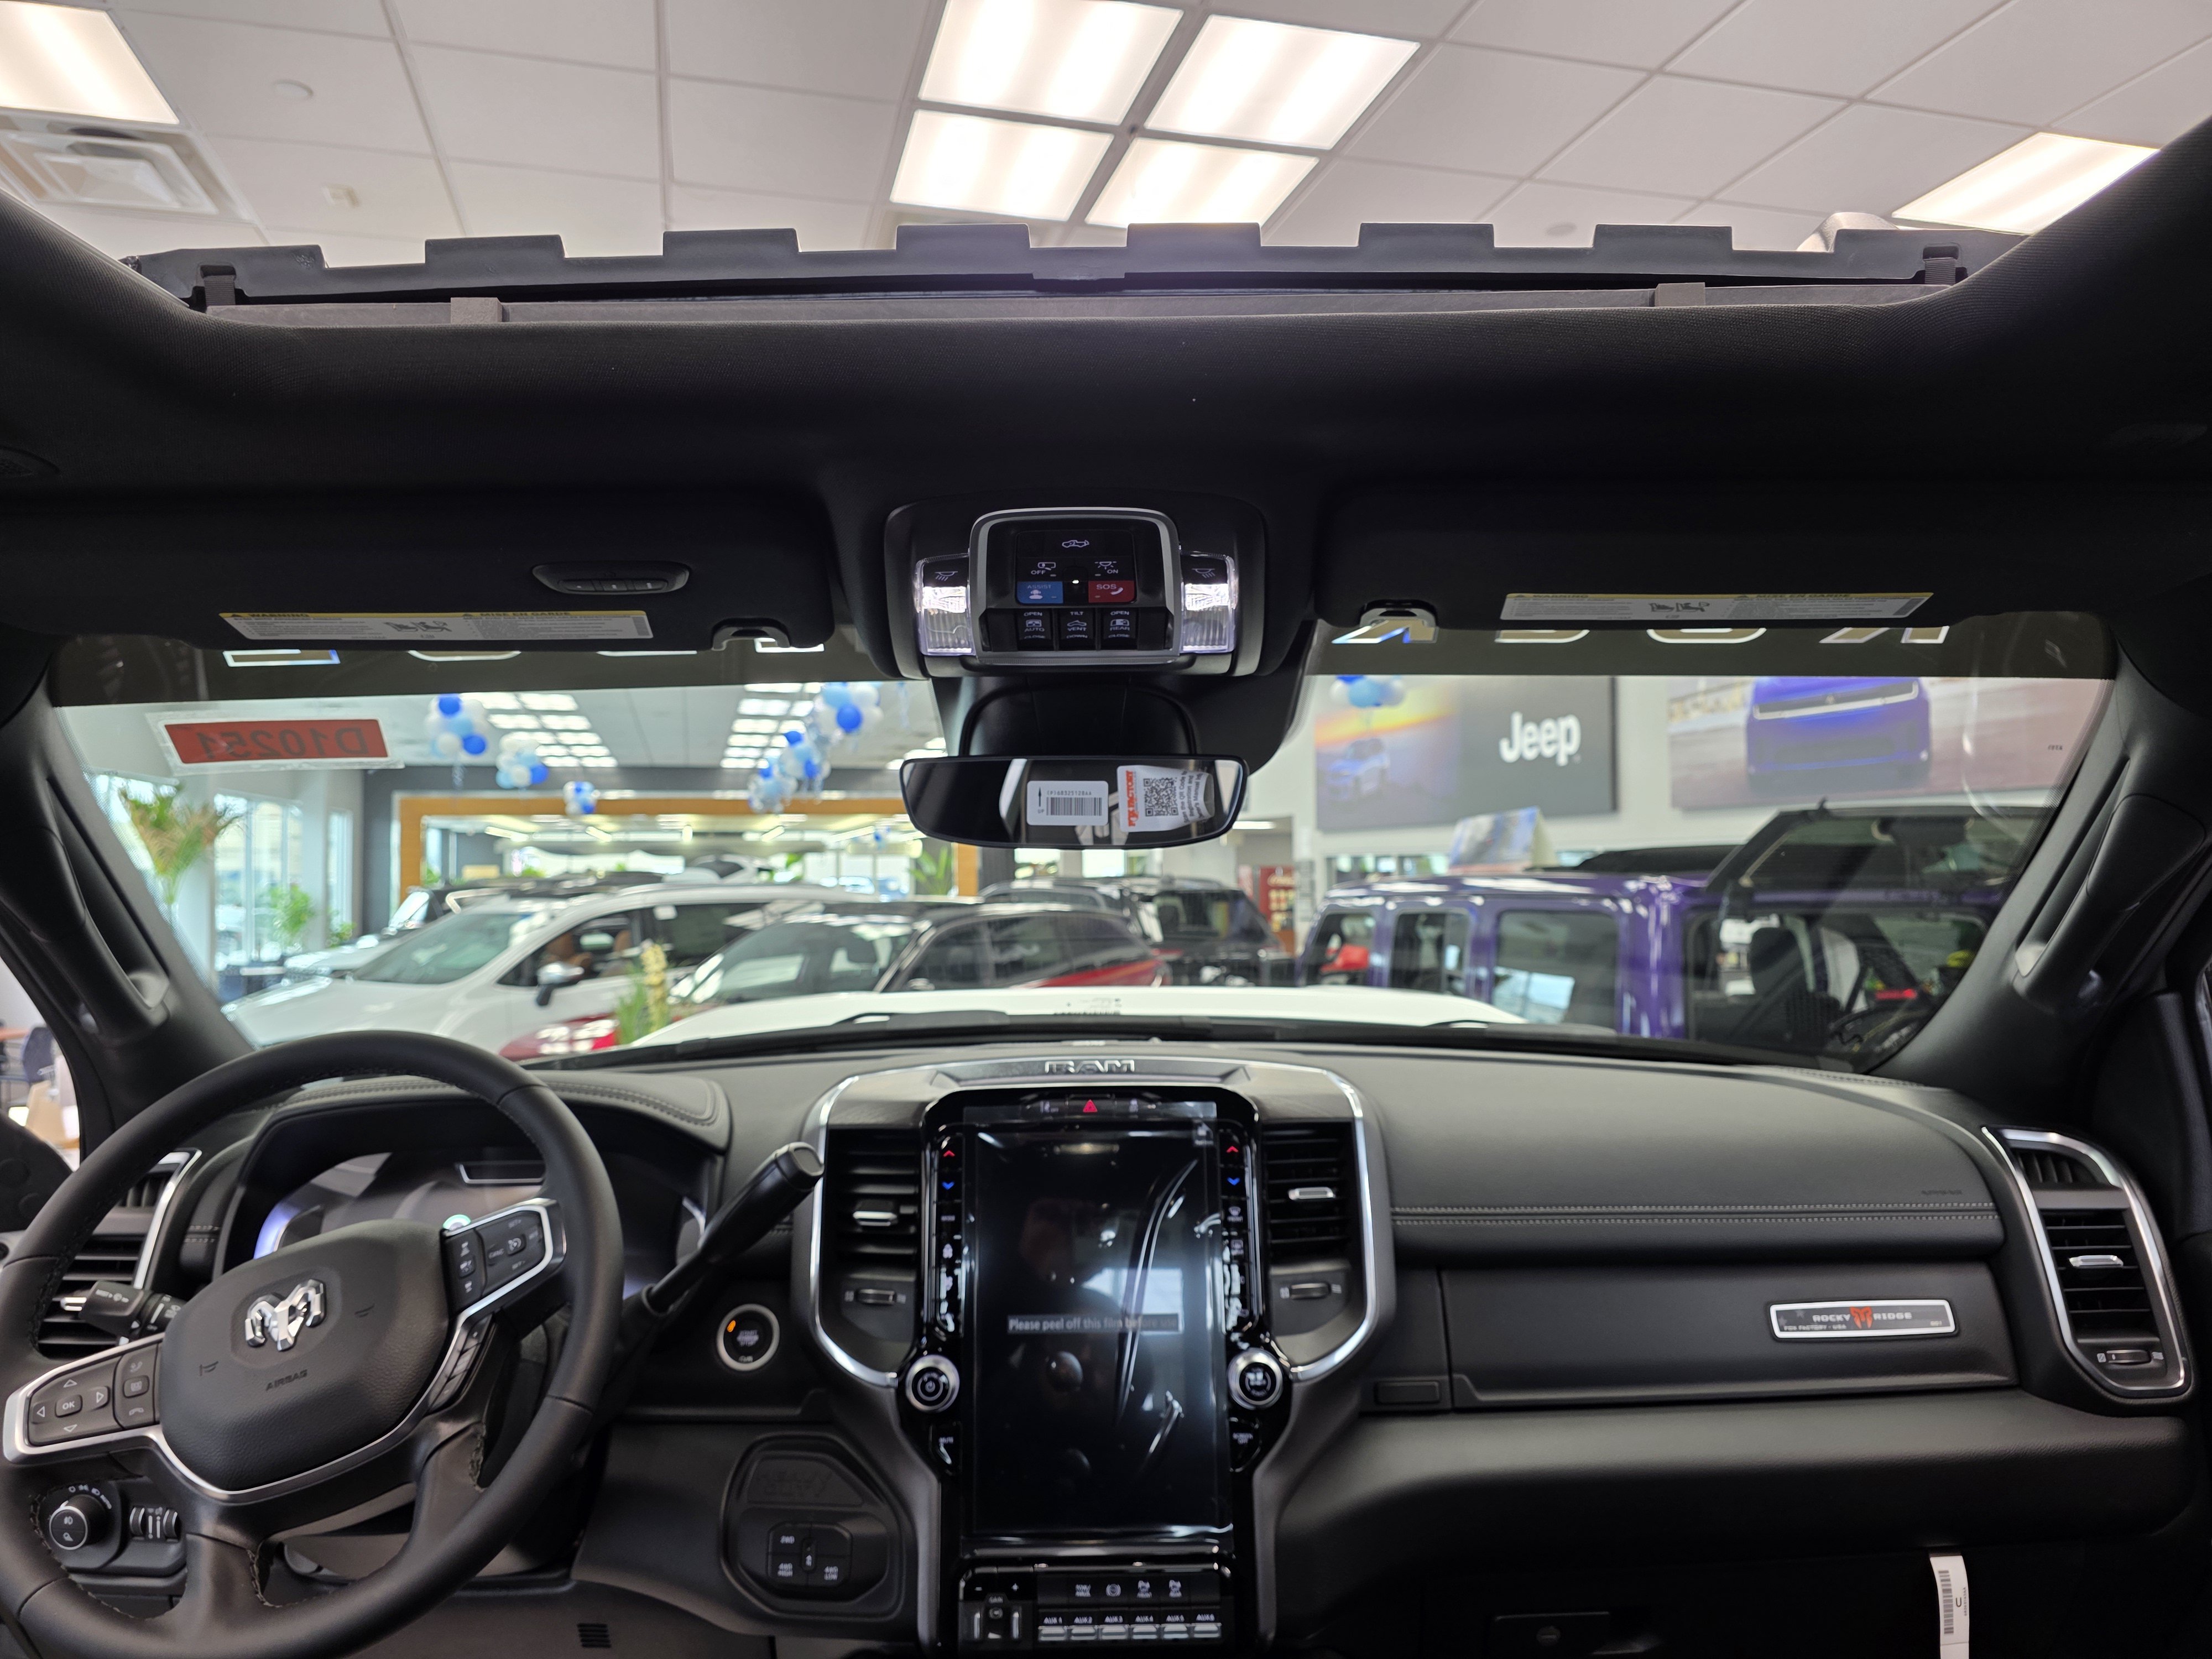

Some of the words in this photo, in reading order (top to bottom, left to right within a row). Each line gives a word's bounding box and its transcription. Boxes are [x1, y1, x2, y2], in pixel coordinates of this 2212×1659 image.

[1499, 711, 1580, 766] Jeep
[1125, 770, 1137, 808] FACTORY
[1179, 791, 1186, 800] QR
[1191, 781, 1201, 801] Manual
[1186, 785, 1194, 817] Registration
[1045, 1060, 1135, 1073] RAM
[1008, 1318, 1041, 1331] Please
[1042, 1318, 1065, 1332] peel
[1065, 1317, 1082, 1330] off
[1083, 1317, 1102, 1329] this
[1812, 1314, 1851, 1323] ROCKY
[1874, 1312, 1912, 1321] RIDGE
[265, 1369, 308, 1391] AIRBAG
[62, 1401, 75, 1410] OK
[780, 1535, 795, 1545] 2WD
